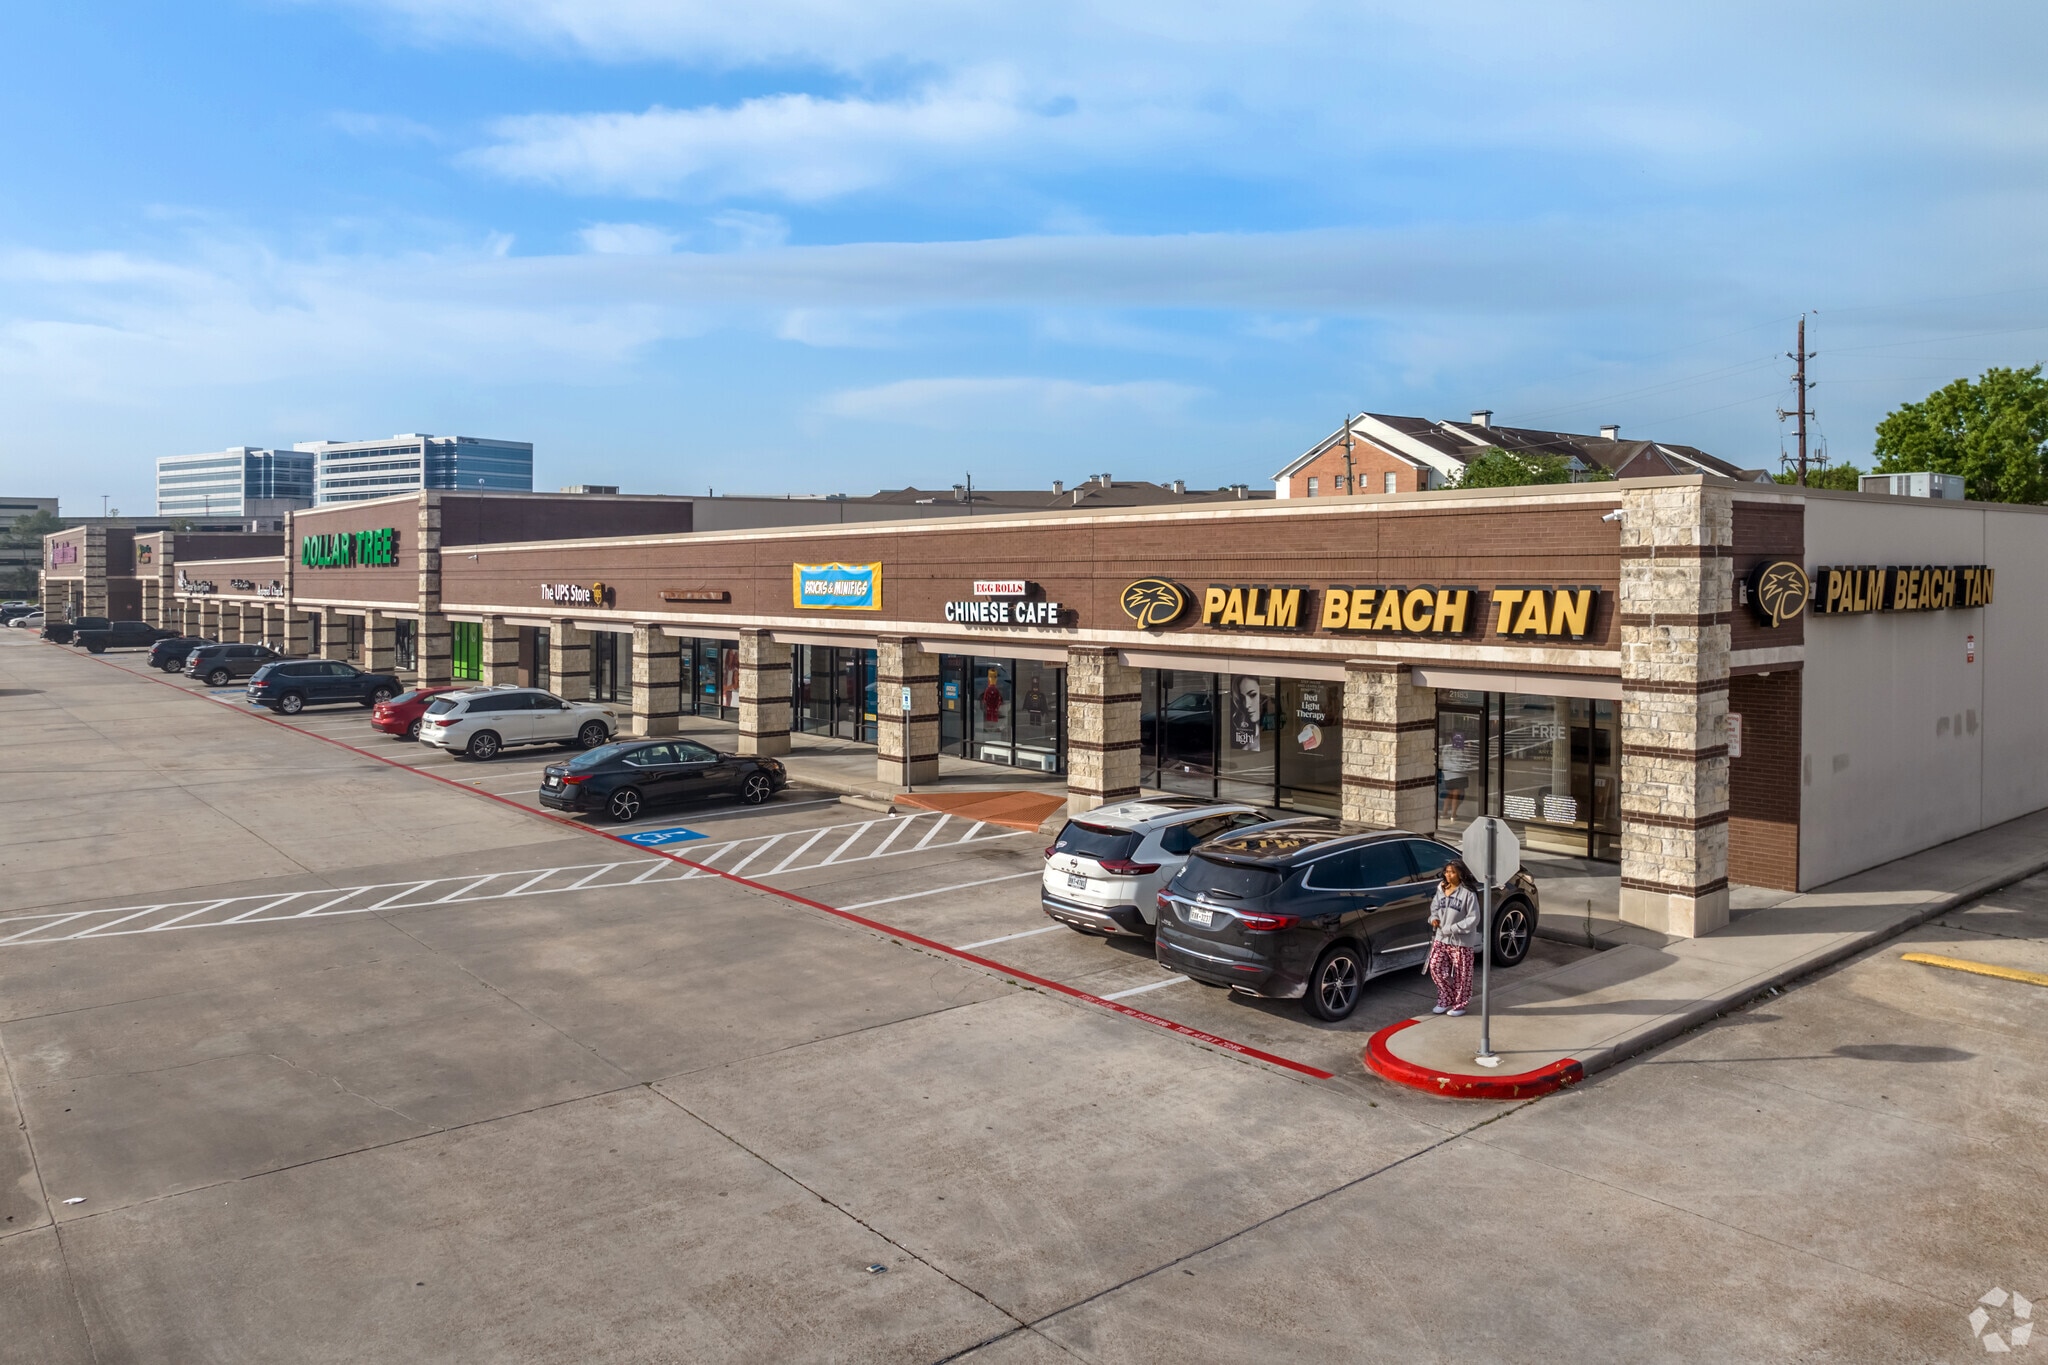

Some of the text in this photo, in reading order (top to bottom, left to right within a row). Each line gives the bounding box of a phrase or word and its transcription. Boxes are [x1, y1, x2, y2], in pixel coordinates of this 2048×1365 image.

[301, 527, 393, 567] DOLLAR TREE
[541, 583, 591, 602] The UPS Store
[804, 580, 868, 596] BRICKS & MINIFIGS
[976, 583, 1023, 593] EGG ROLLS
[1826, 568, 1995, 614] PALM BEACH TAN
[944, 601, 1058, 624] CHINESE CAFE
[1202, 587, 1592, 636] PALM BEACH TAN
[1303, 693, 1318, 702] Red
[1301, 701, 1320, 711] Light
[1296, 709, 1326, 721] Therapy
[1235, 731, 1255, 745] light
[1531, 724, 1566, 740] FREE
